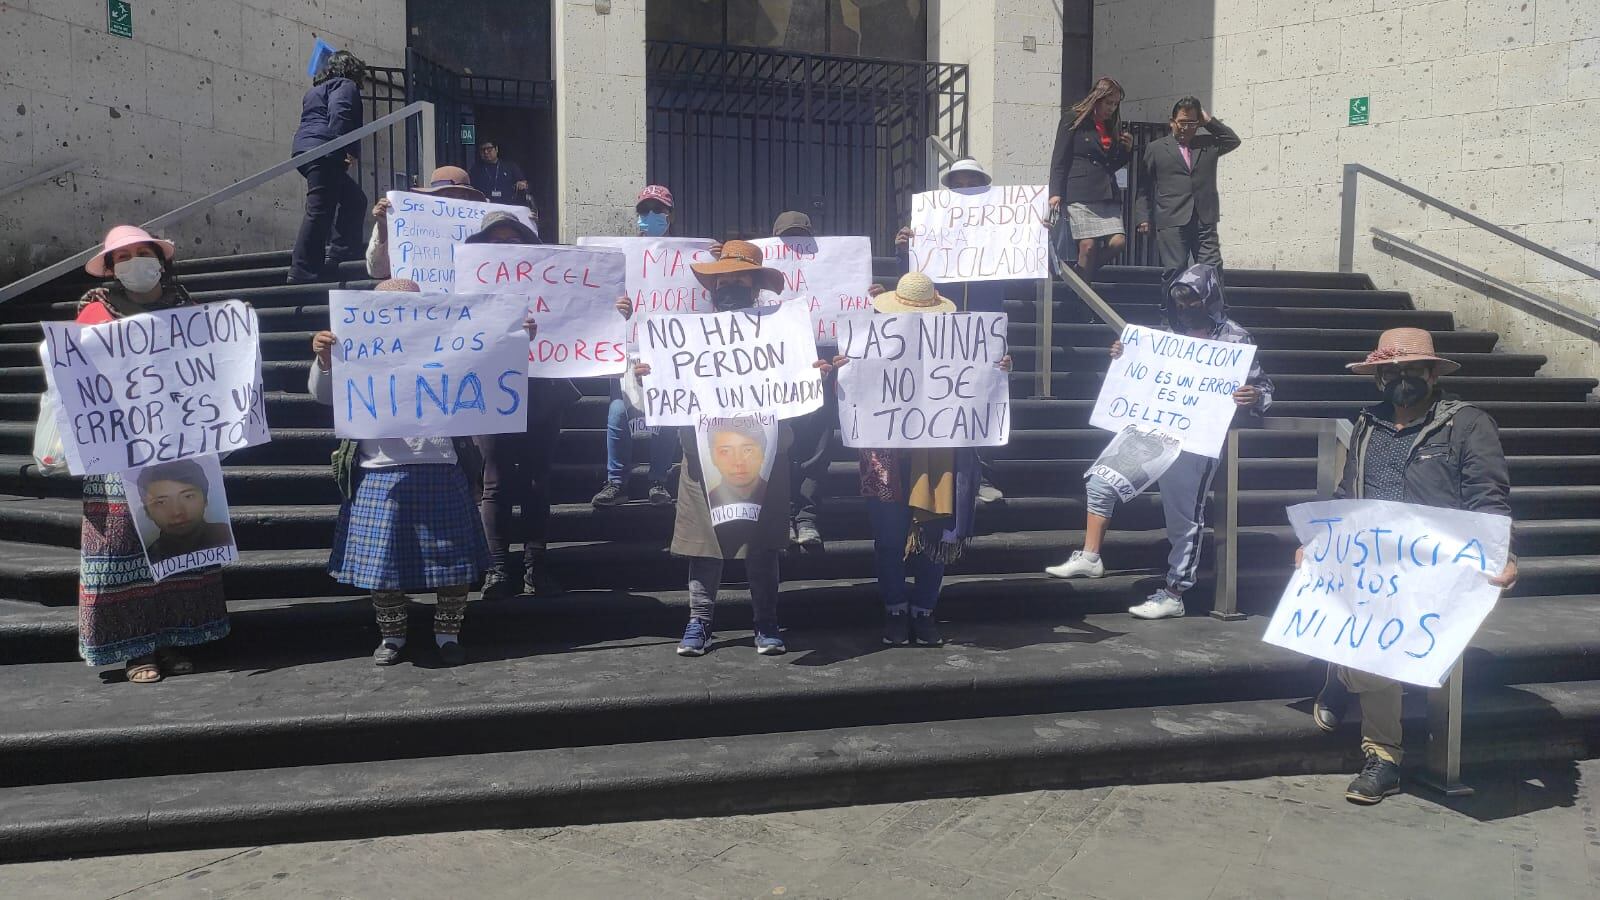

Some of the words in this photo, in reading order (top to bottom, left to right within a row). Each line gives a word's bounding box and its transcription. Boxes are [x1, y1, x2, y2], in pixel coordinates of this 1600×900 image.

[917, 189, 951, 213] NO
[1003, 184, 1045, 205] HAY
[398, 241, 441, 263] PARA
[764, 243, 816, 261] DIMOS
[911, 223, 968, 247] PARA
[1010, 226, 1043, 245] UN
[476, 261, 601, 288] CARCEL
[909, 246, 1047, 279] VIOLADOR
[343, 305, 472, 325] JUSTICIA
[646, 317, 686, 349] NO
[700, 311, 761, 346] HAY
[48, 326, 88, 369] LA
[343, 337, 404, 361] PARA
[434, 332, 486, 353] LOS
[528, 339, 625, 363] ADORES
[845, 317, 906, 361] LAS
[1122, 327, 1139, 347] LA
[1150, 333, 1243, 368] VIOLACION
[672, 341, 785, 380] PERDON
[76, 373, 113, 408] NO
[125, 365, 164, 400] ES
[175, 353, 216, 387] UN
[347, 362, 524, 422] NIÑAS
[882, 367, 916, 403] NO
[928, 365, 977, 401] SE
[1124, 361, 1148, 380] NO
[1154, 370, 1171, 384] ES
[1176, 375, 1194, 389] UN
[1198, 377, 1240, 396] ERROR
[646, 387, 701, 417] PARA
[716, 385, 744, 409] UN
[1108, 397, 1191, 431] DELITO
[1157, 387, 1177, 402] ES
[1182, 395, 1199, 407] UN
[74, 401, 164, 445] ERROR
[182, 394, 220, 427] ES
[126, 421, 244, 468] DELITO
[1309, 517, 1486, 571] JUSTICIA
[152, 545, 232, 578] VIOLADOR!
[1356, 567, 1399, 598] LOS
[1283, 600, 1441, 659] NIÑOS
